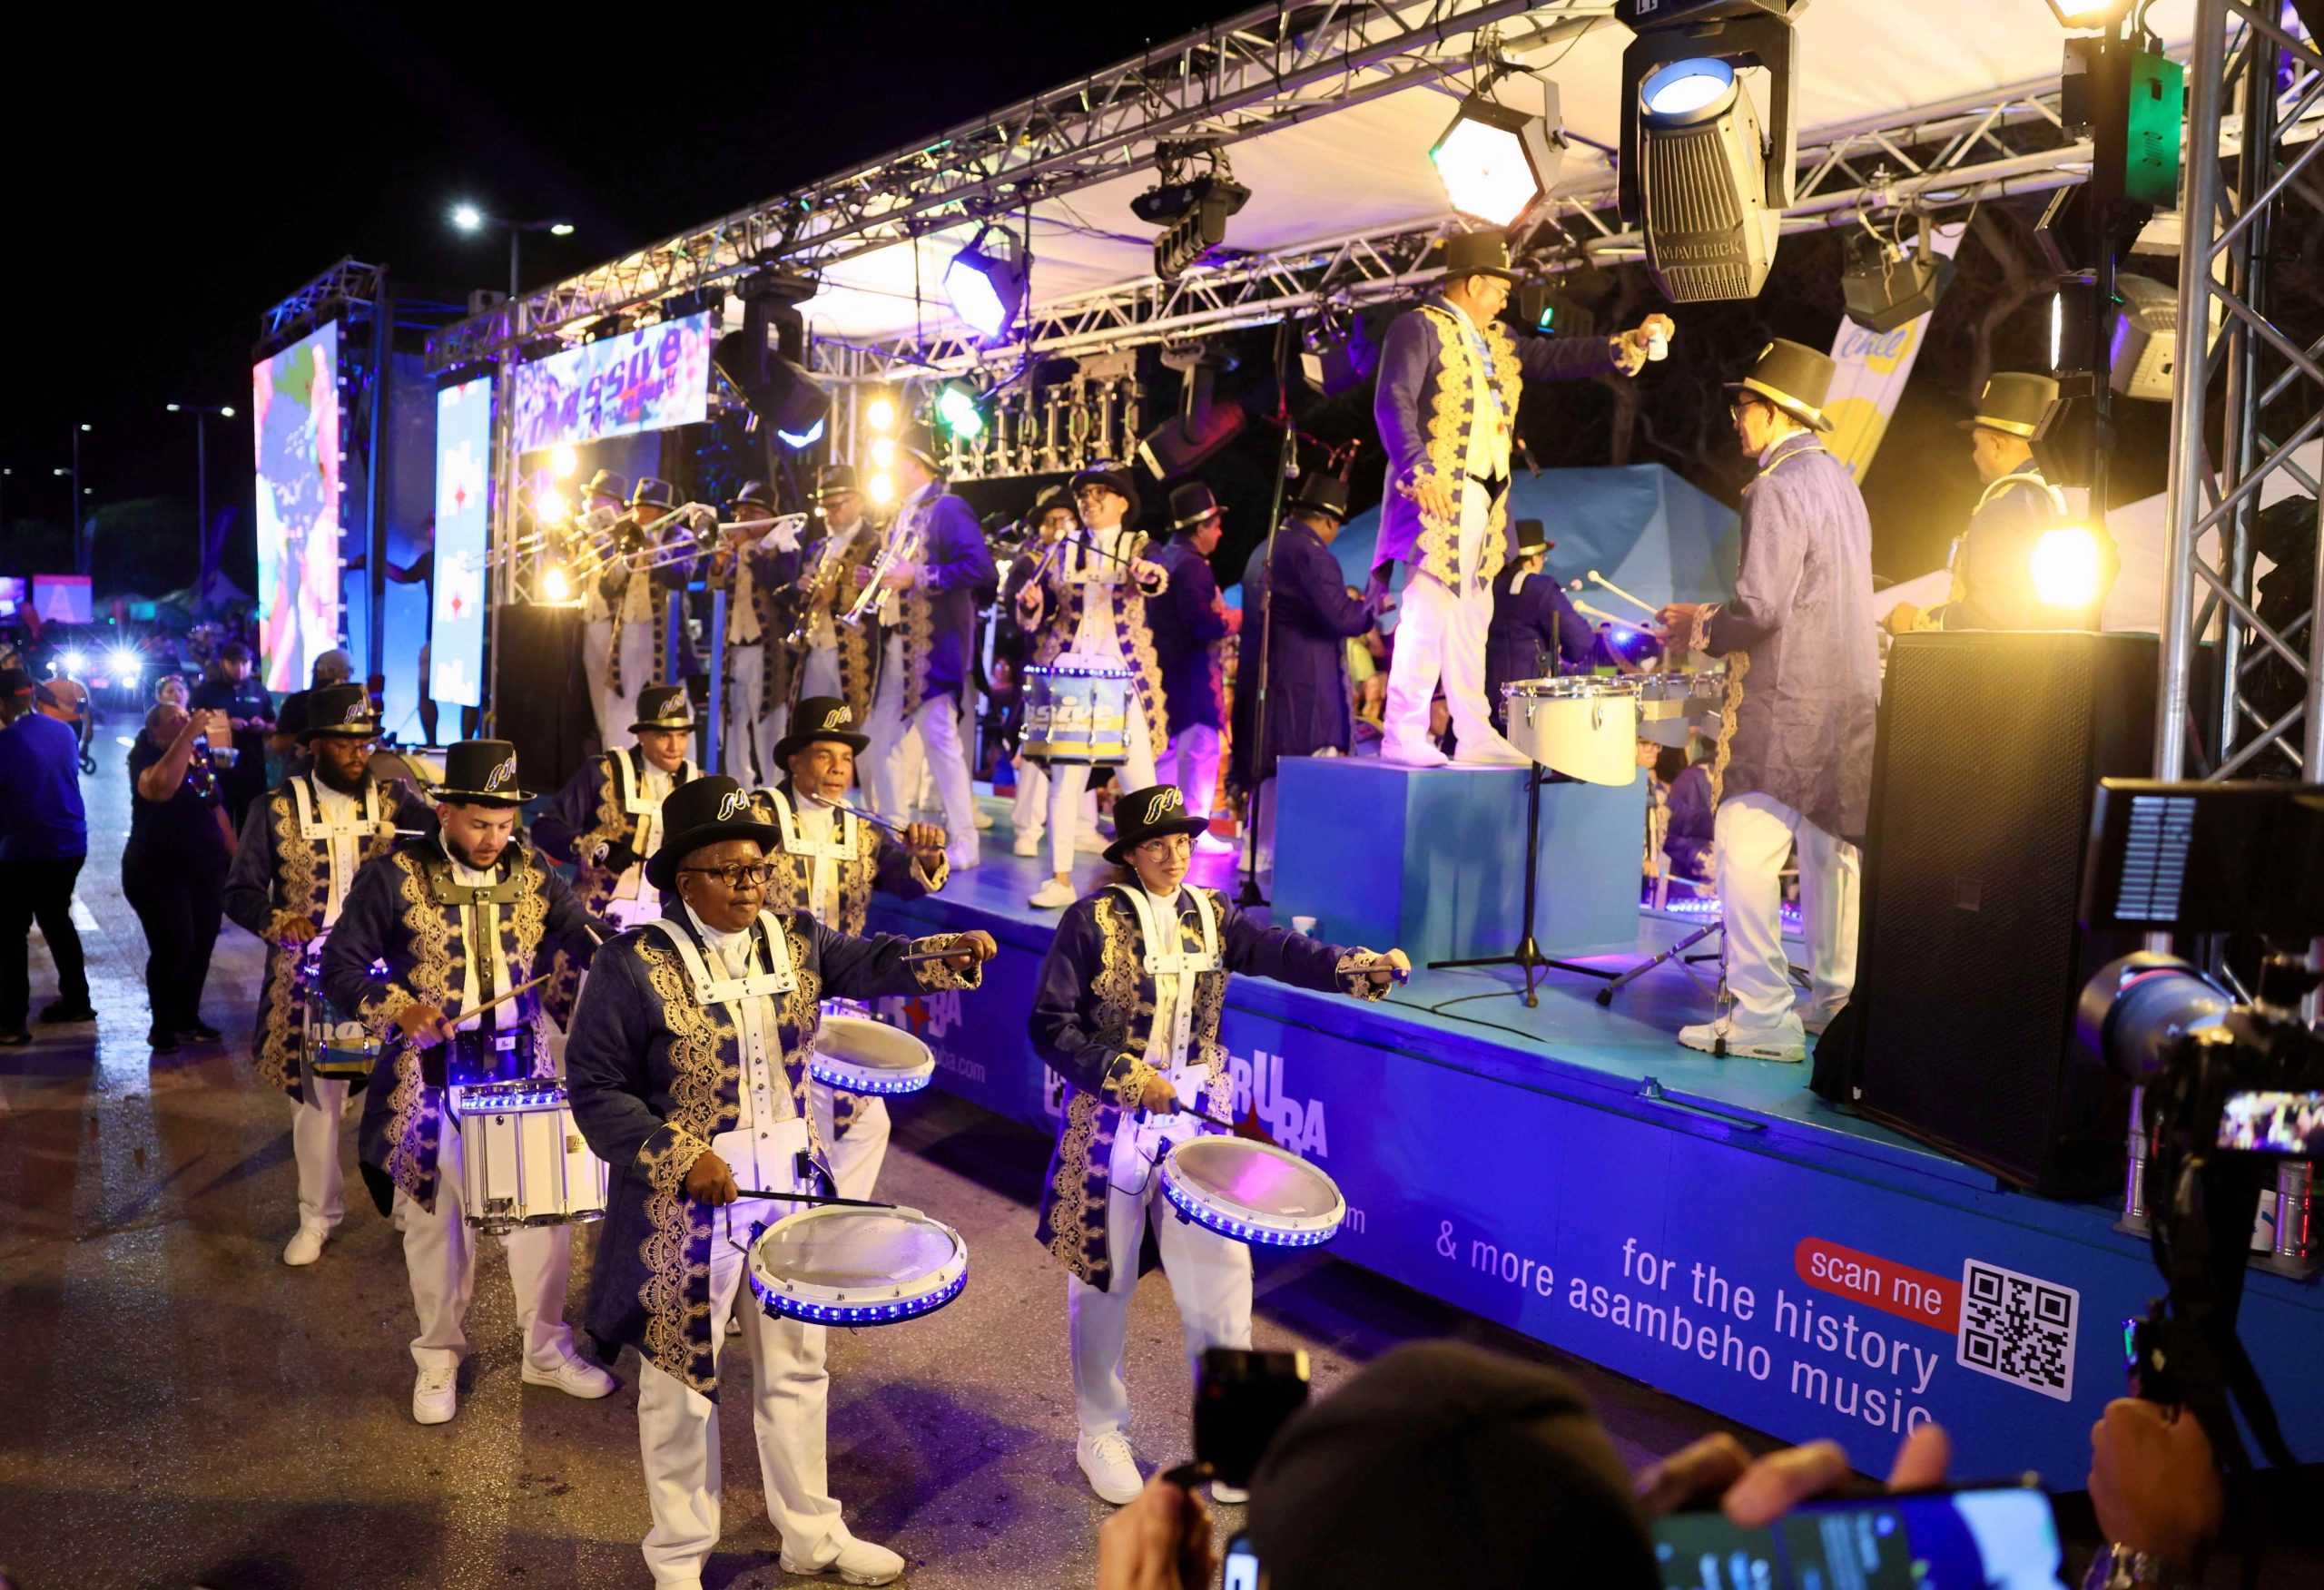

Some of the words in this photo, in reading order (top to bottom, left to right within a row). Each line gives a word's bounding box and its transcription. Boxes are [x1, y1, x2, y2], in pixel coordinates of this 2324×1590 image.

[1658, 240, 1743, 260] MAVERICK
[1436, 1220, 1457, 1261] &
[1472, 1240, 1554, 1297] more
[1569, 1277, 1771, 1380] asambeho
[1791, 1359, 1932, 1439] music
[1622, 1238, 1677, 1291] for
[1691, 1262, 1756, 1320] the
[1774, 1289, 1939, 1395] history
[1810, 1251, 1881, 1296] scan
[1893, 1277, 1943, 1315] me
